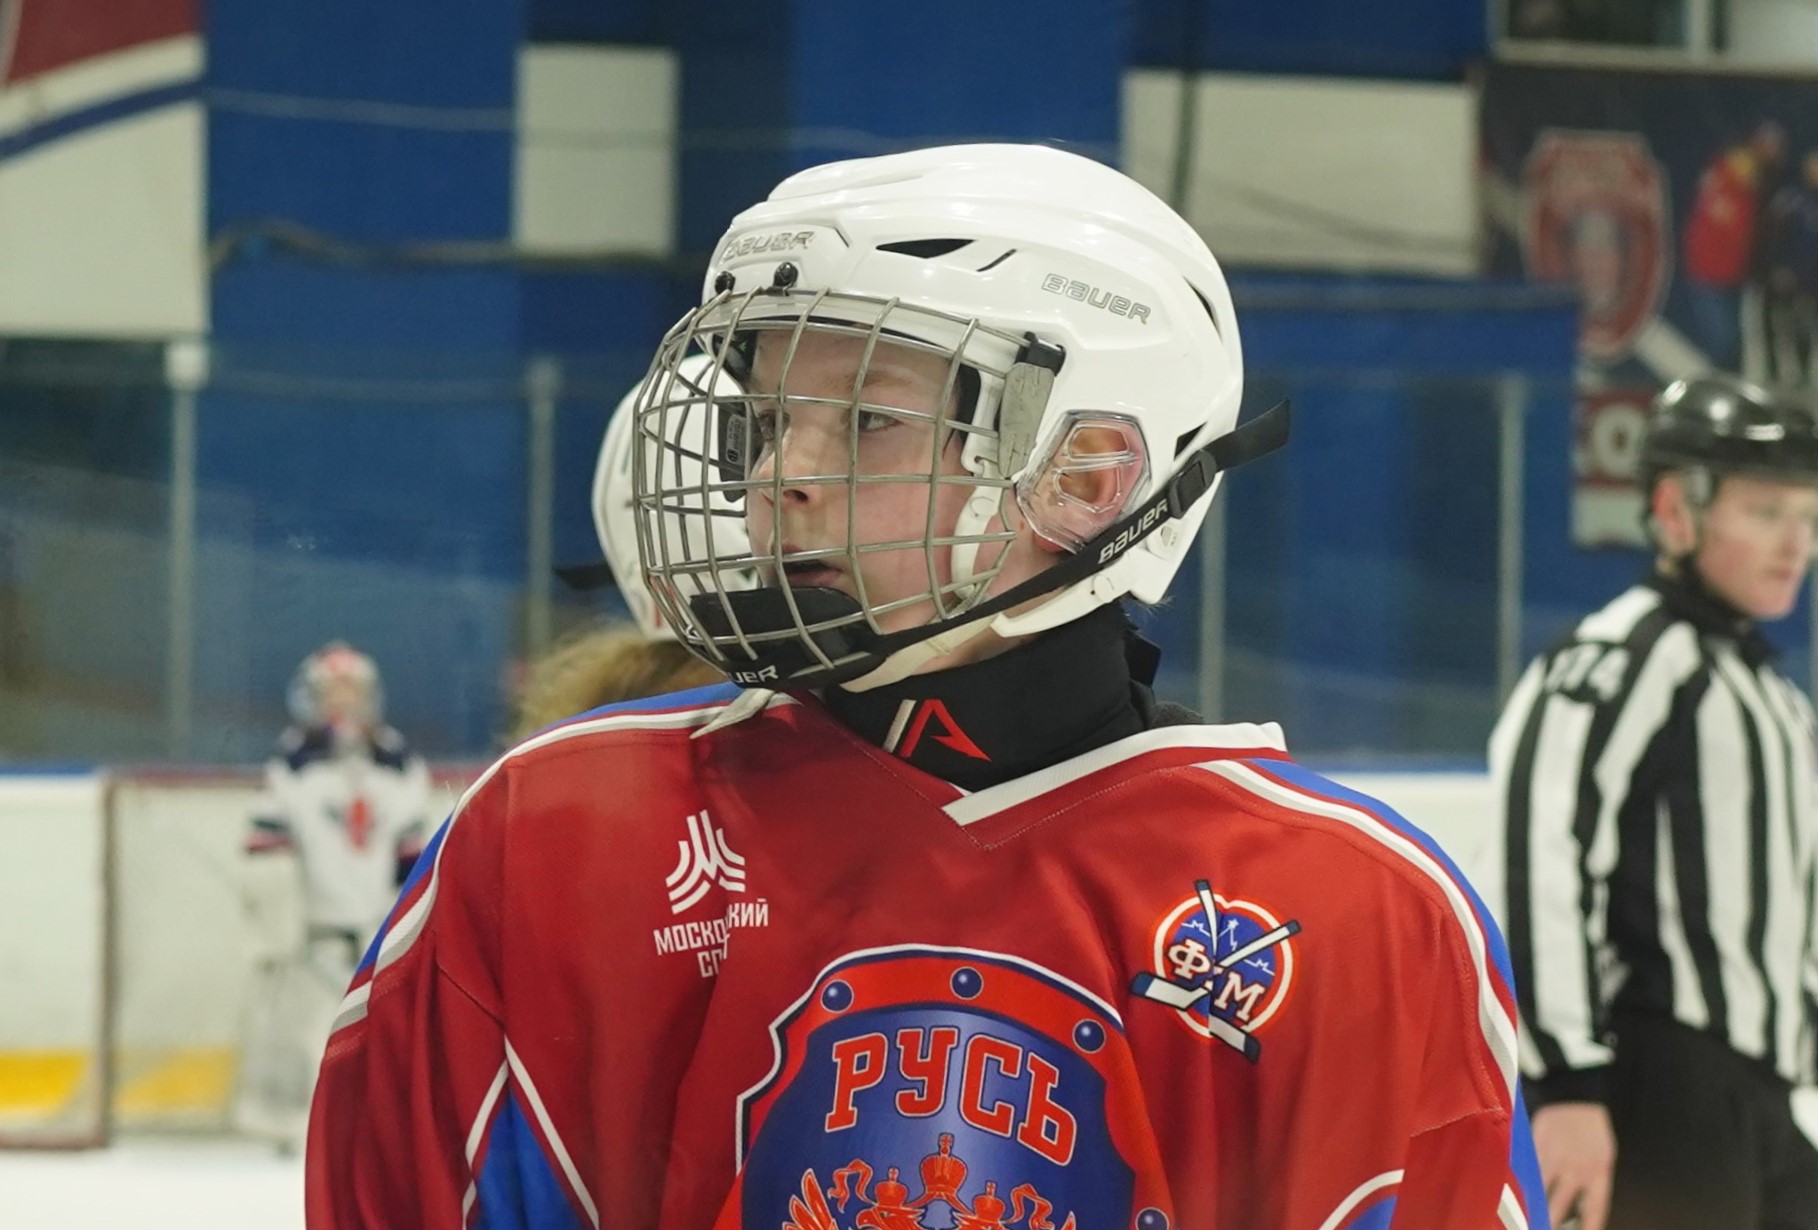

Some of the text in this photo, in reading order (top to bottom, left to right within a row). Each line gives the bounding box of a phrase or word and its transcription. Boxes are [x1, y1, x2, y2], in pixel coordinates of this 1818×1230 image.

[1041, 272, 1152, 325] BAUER
[1097, 498, 1169, 565] BAUER
[653, 898, 769, 956] МОСКОКИЙ
[825, 1027, 1077, 1166] РУСЬ
